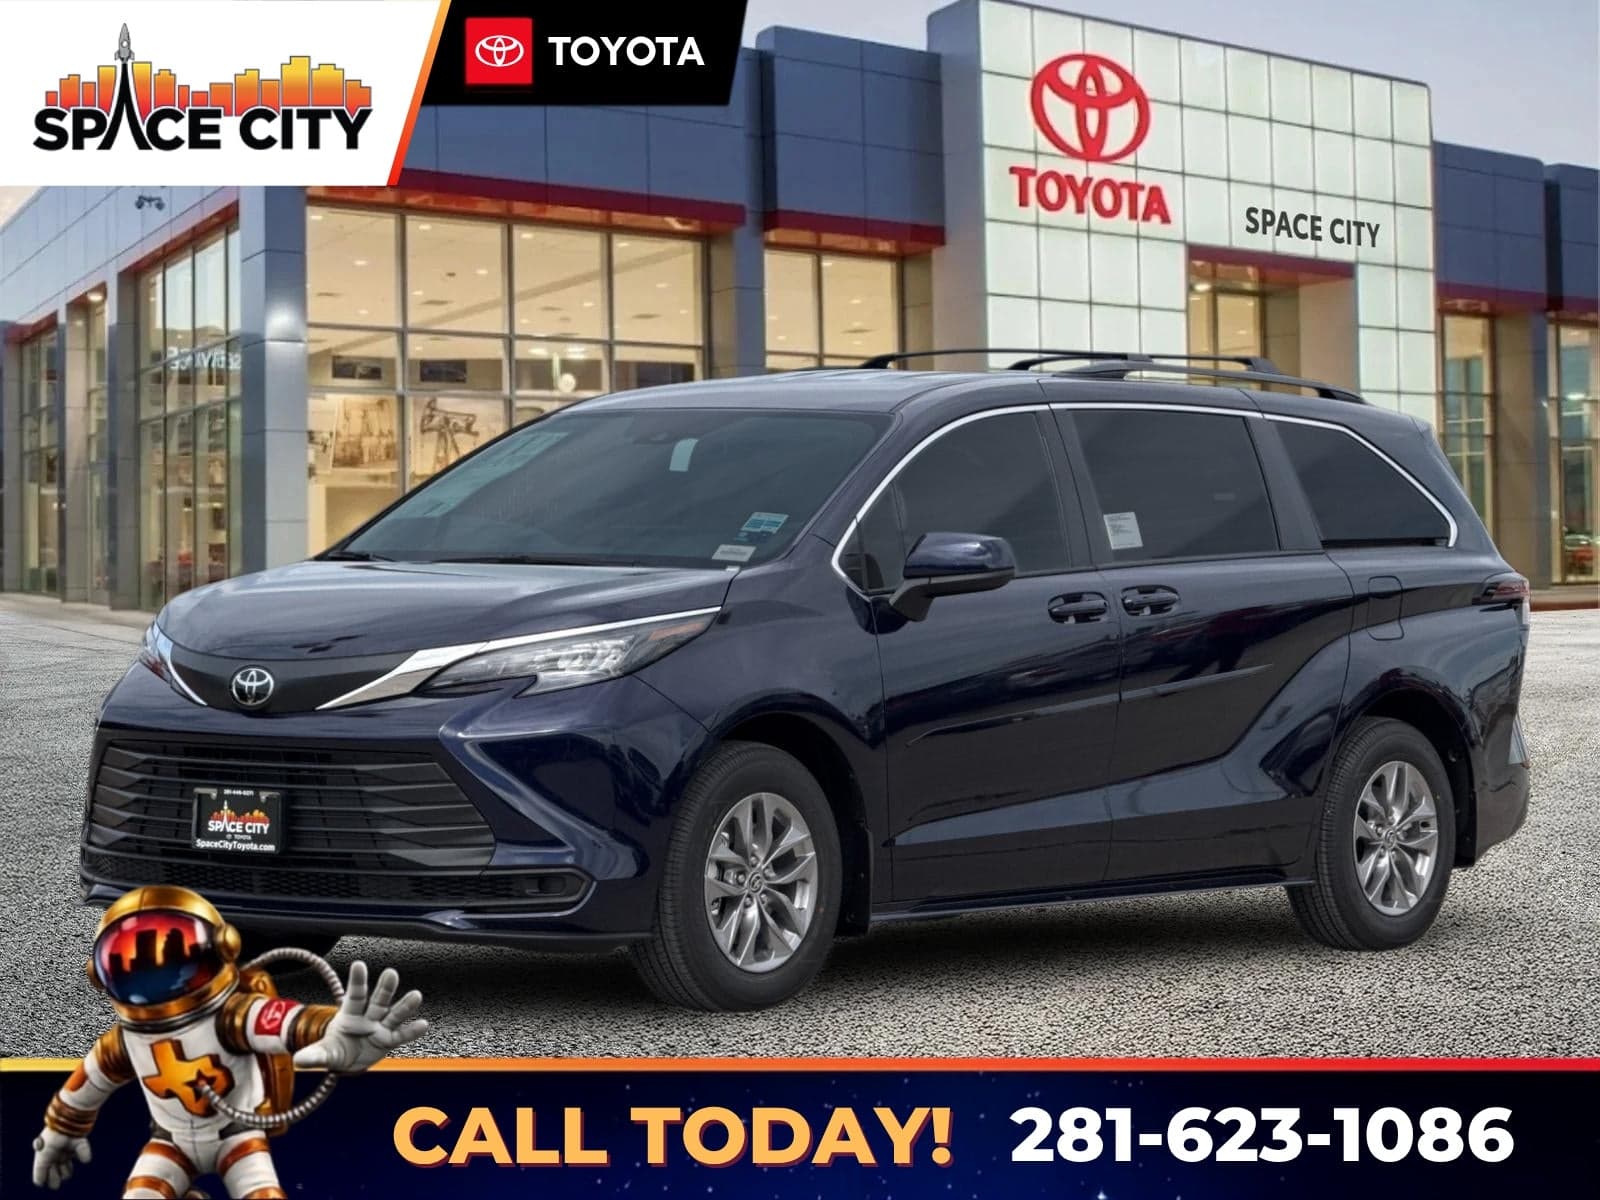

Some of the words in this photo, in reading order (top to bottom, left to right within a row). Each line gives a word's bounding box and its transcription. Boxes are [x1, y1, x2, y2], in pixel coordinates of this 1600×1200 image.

[1008, 166, 1171, 224] TOYOTA
[1245, 207, 1323, 242] SPACE
[1329, 217, 1381, 248] CITY
[208, 819, 243, 833] SPACE
[245, 822, 269, 834] CITY
[195, 839, 276, 852] SpaceCityToyota.com
